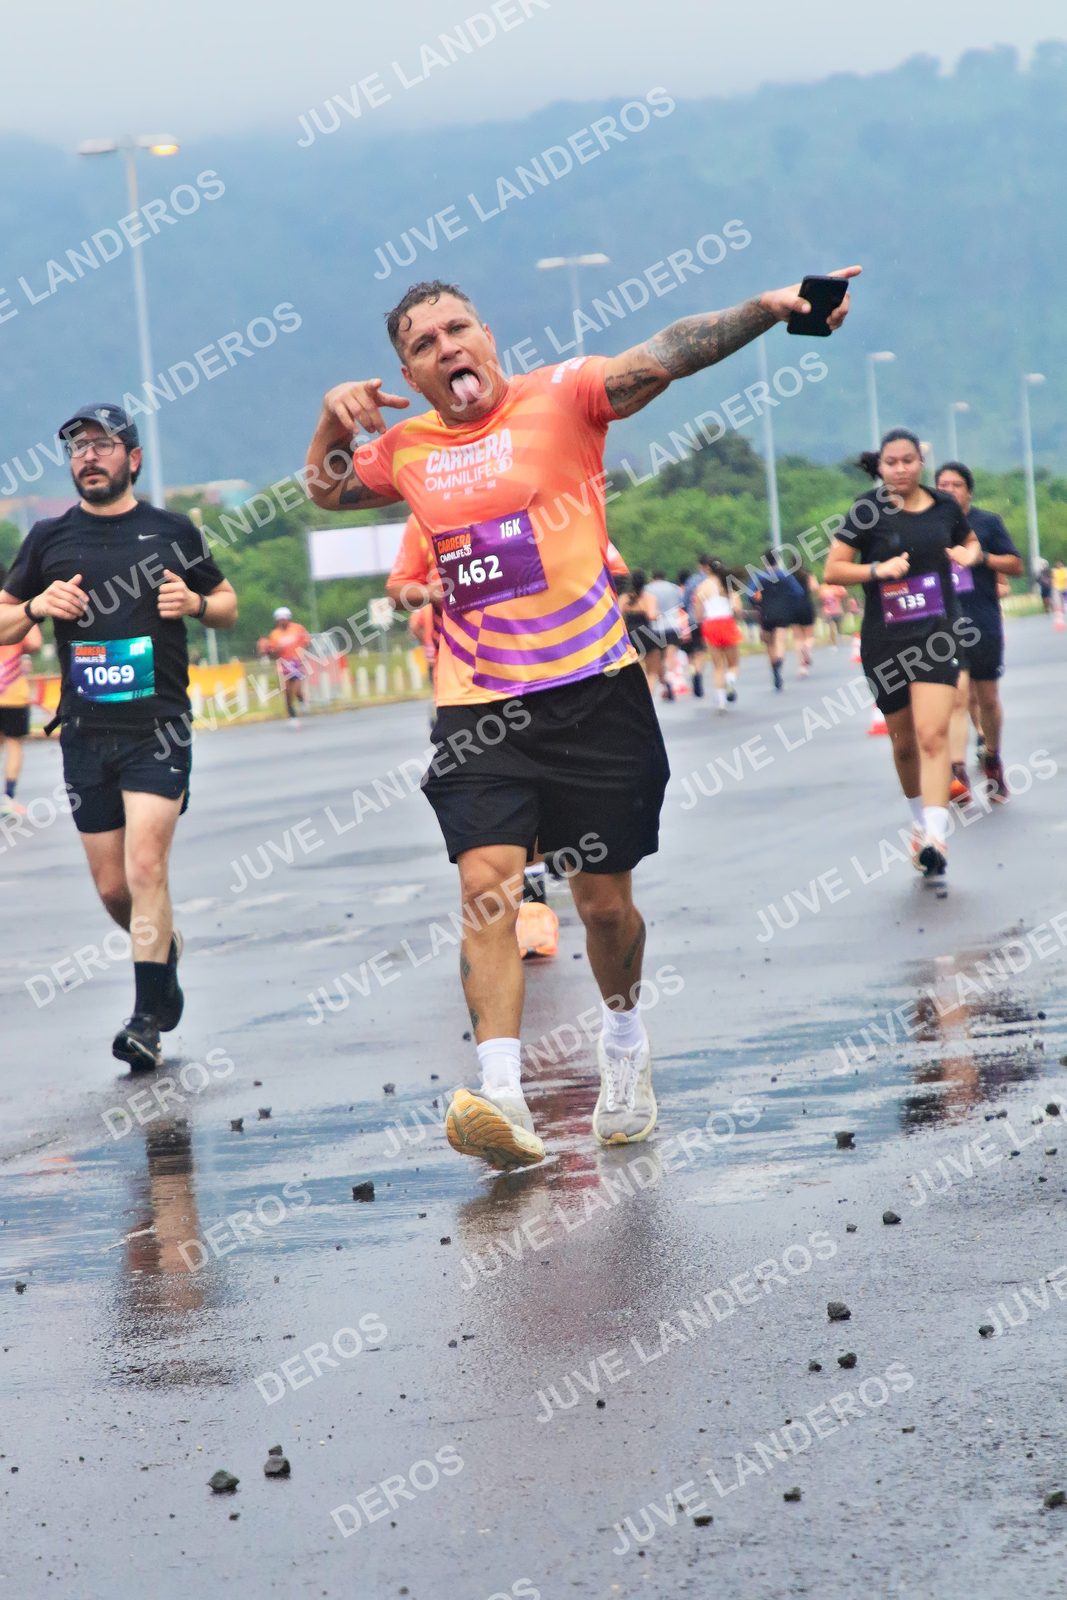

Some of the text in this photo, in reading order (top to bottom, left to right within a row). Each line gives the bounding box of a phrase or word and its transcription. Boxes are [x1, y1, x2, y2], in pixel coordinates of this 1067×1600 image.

[426, 428, 512, 474] CARRERA
[458, 555, 503, 587] 462
[83, 664, 135, 685] 1069
